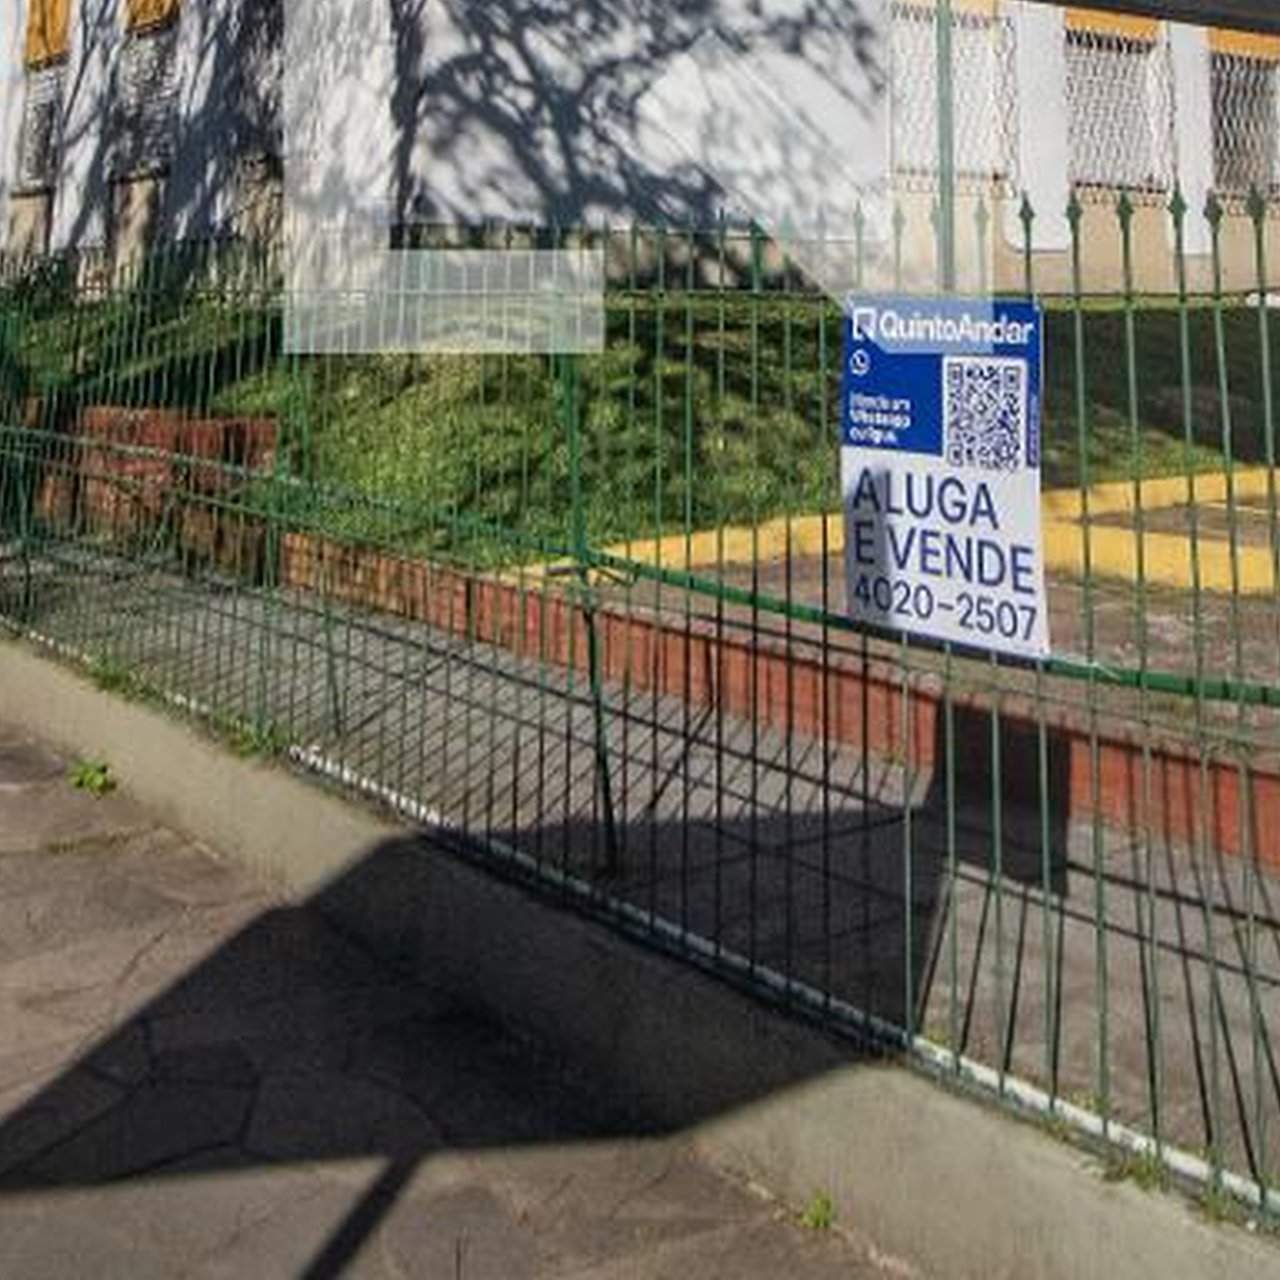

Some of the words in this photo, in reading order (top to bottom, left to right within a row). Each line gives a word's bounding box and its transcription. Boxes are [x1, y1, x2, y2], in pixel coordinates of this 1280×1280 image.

[879, 309, 1034, 345] QuintoAndar
[852, 467, 1000, 530] ALUGA
[854, 520, 876, 565] E
[886, 523, 1037, 596] VENDE
[853, 574, 1038, 642] 4020-2507
